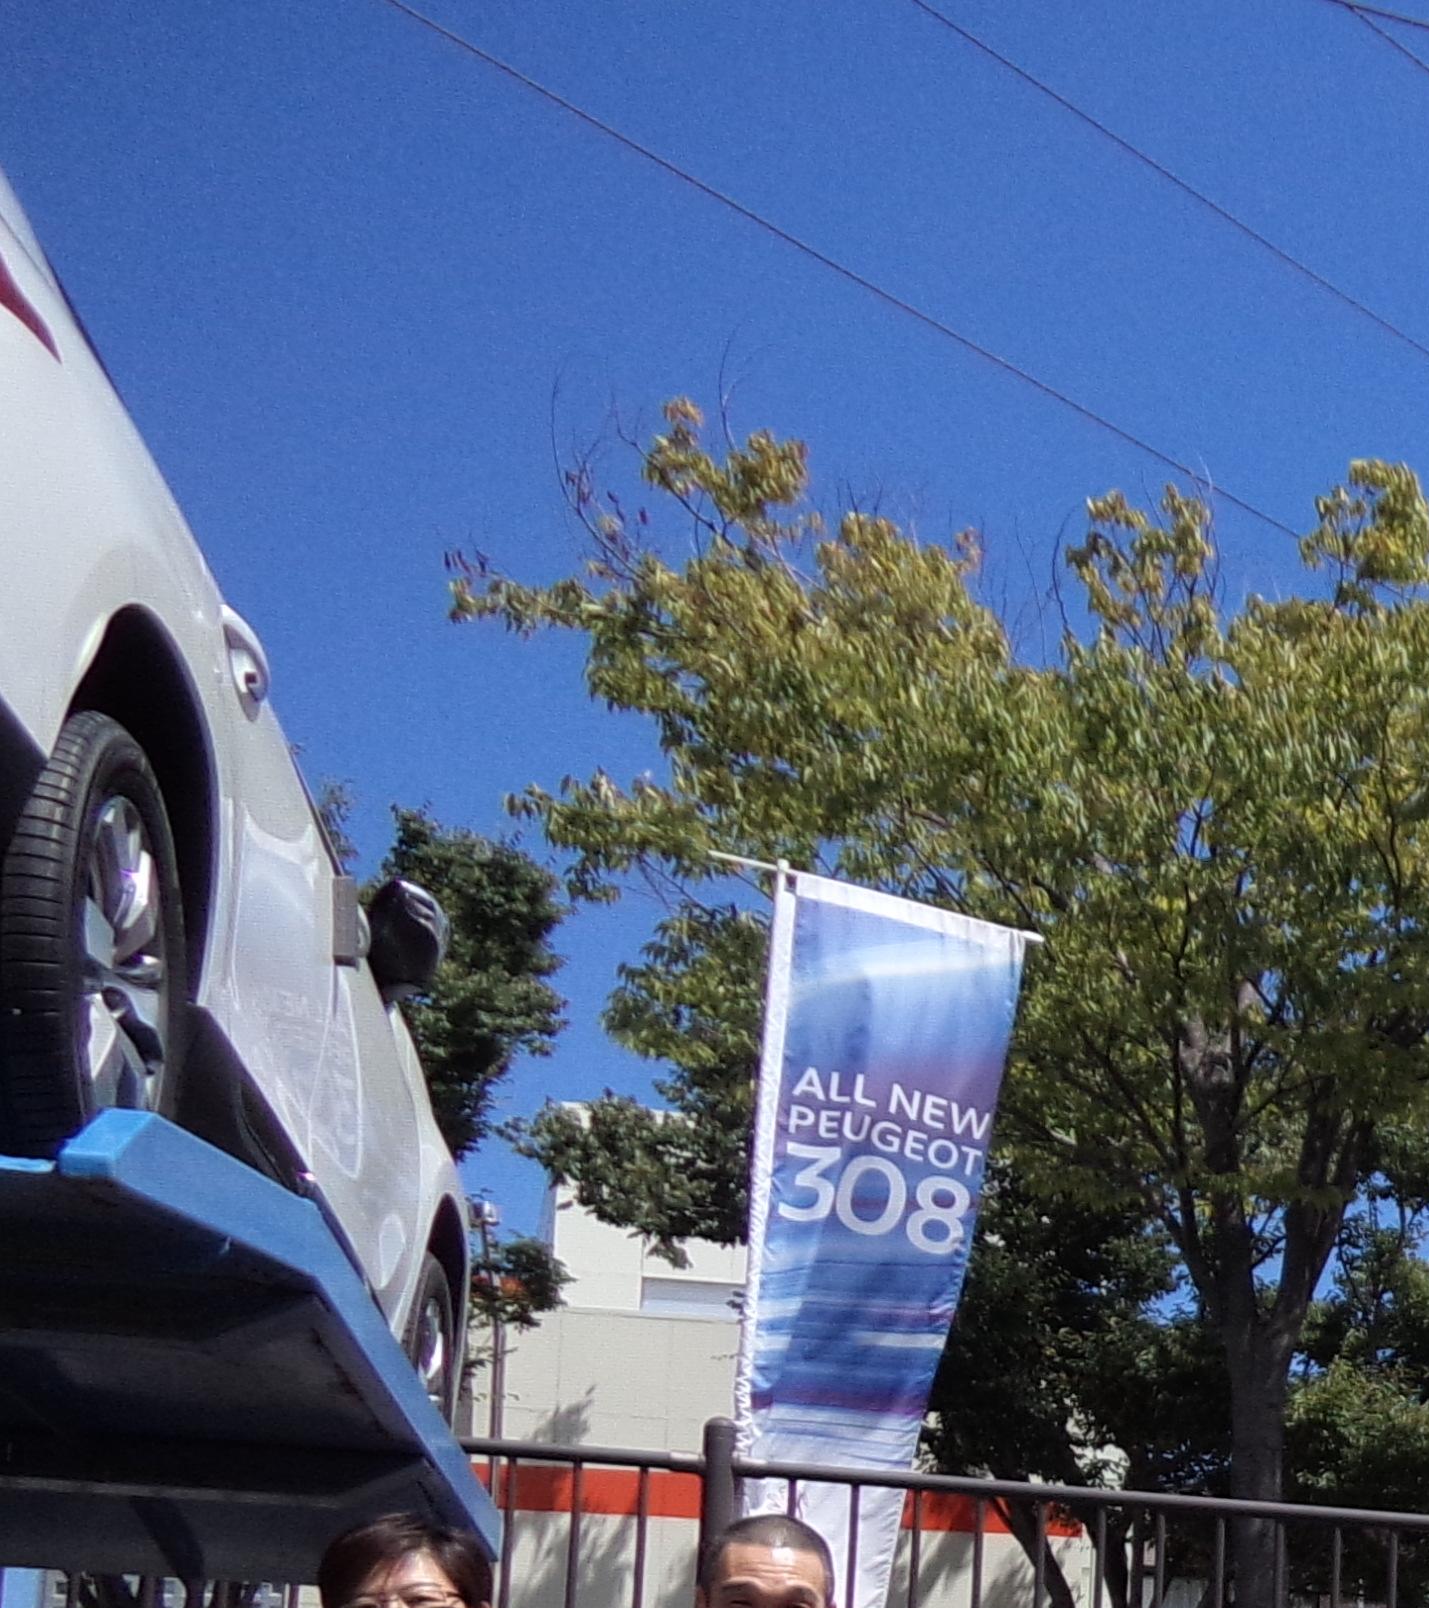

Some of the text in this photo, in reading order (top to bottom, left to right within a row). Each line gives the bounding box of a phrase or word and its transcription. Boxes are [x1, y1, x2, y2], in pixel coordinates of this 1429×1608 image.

[788, 1104, 983, 1177] PEUGEOT
[791, 1066, 991, 1141] ALL NEW
[777, 1141, 971, 1255] 308
